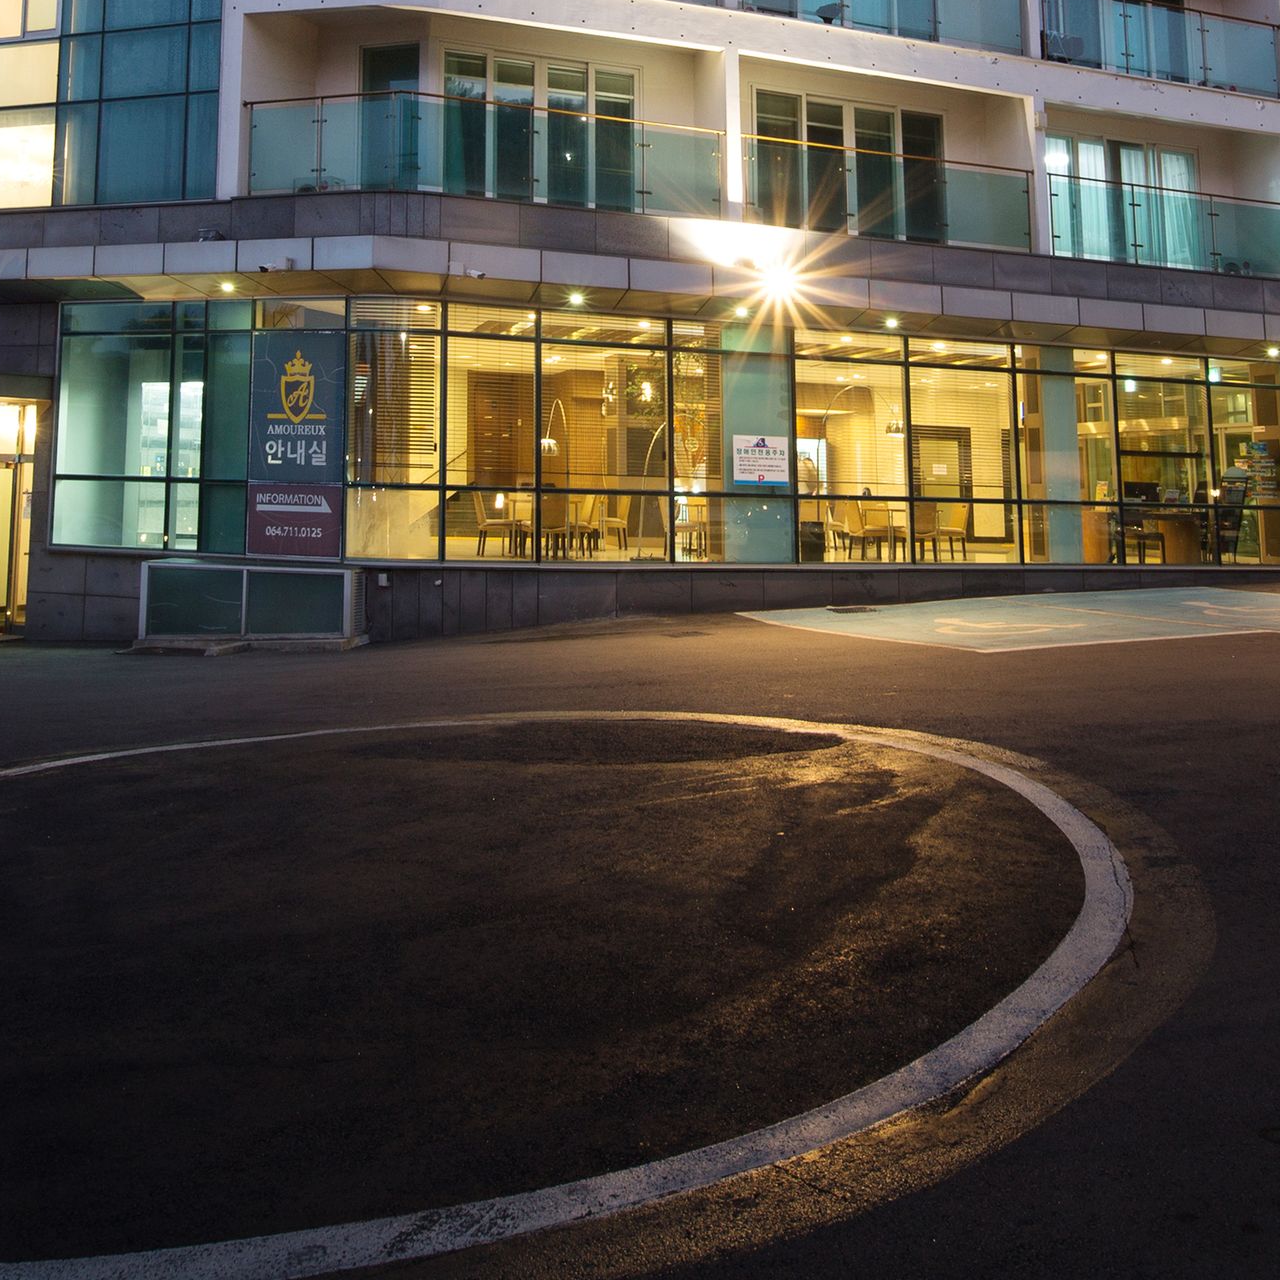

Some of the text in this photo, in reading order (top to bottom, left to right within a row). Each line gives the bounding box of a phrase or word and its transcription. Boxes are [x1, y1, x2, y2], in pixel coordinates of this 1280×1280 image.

[266, 424, 326, 436] AMOUREUX
[265, 438, 328, 466] 안내실
[256, 492, 323, 506] INFORMATION
[265, 525, 323, 539] 064.711.0125
